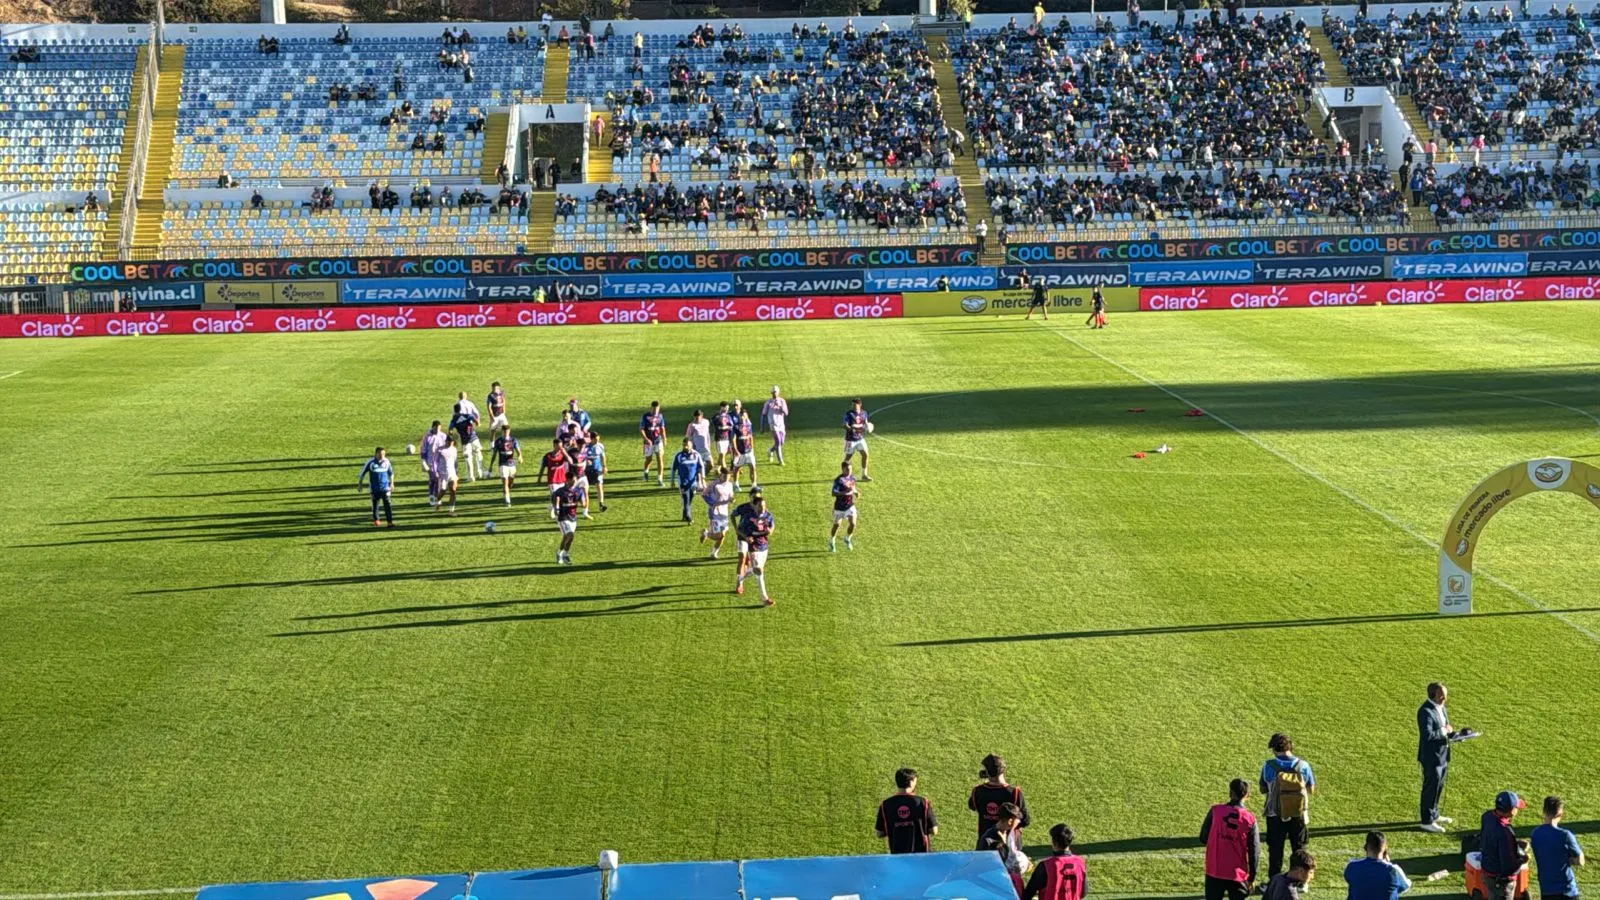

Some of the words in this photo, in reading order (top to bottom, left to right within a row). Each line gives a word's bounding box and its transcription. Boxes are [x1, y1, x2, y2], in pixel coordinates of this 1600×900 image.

[1344, 88, 1354, 102] B
[546, 104, 555, 119] A
[1227, 239, 1308, 256] COOLBET
[1338, 237, 1418, 252] COOLBET
[1449, 234, 1531, 249] COOLBET
[1560, 232, 1600, 246] COO
[868, 248, 946, 265] COOLBET
[1007, 244, 1088, 261] COOLBET
[1117, 242, 1197, 259] COOLBET
[309, 258, 393, 275] COOLBET
[422, 257, 505, 274] COOLBET
[535, 256, 620, 274] COOLBET
[648, 253, 728, 270] COOLBET
[758, 251, 838, 268] COOLBET
[71, 264, 160, 281] COOLBET
[192, 261, 277, 278] COOLBET
[1134, 269, 1251, 283] TERRAWIND
[1264, 265, 1382, 280] TERRAWIND
[1403, 261, 1524, 276] TERRAWIND
[612, 280, 731, 295] TERRAWIND
[743, 278, 862, 293] TERRAWIND
[1465, 286, 1515, 302] Claro
[1545, 284, 1594, 300] Claro
[1053, 294, 1083, 307] libre
[1150, 294, 1199, 311] Claro
[1230, 292, 1279, 309] Claro
[1308, 290, 1358, 307] Claro
[1386, 288, 1436, 304] Claro
[436, 311, 487, 328] Claro
[517, 309, 567, 326] Claro
[599, 306, 650, 324] Claro
[678, 306, 728, 323] Claro
[755, 304, 806, 320] Claro
[833, 303, 883, 319] Claro
[106, 316, 159, 336] Claro
[192, 316, 244, 334] Claro
[275, 314, 327, 332] Claro
[356, 312, 407, 329] Claro
[21, 321, 73, 338] Claro
[1464, 502, 1493, 538] mercado
[1491, 488, 1511, 504] libre
